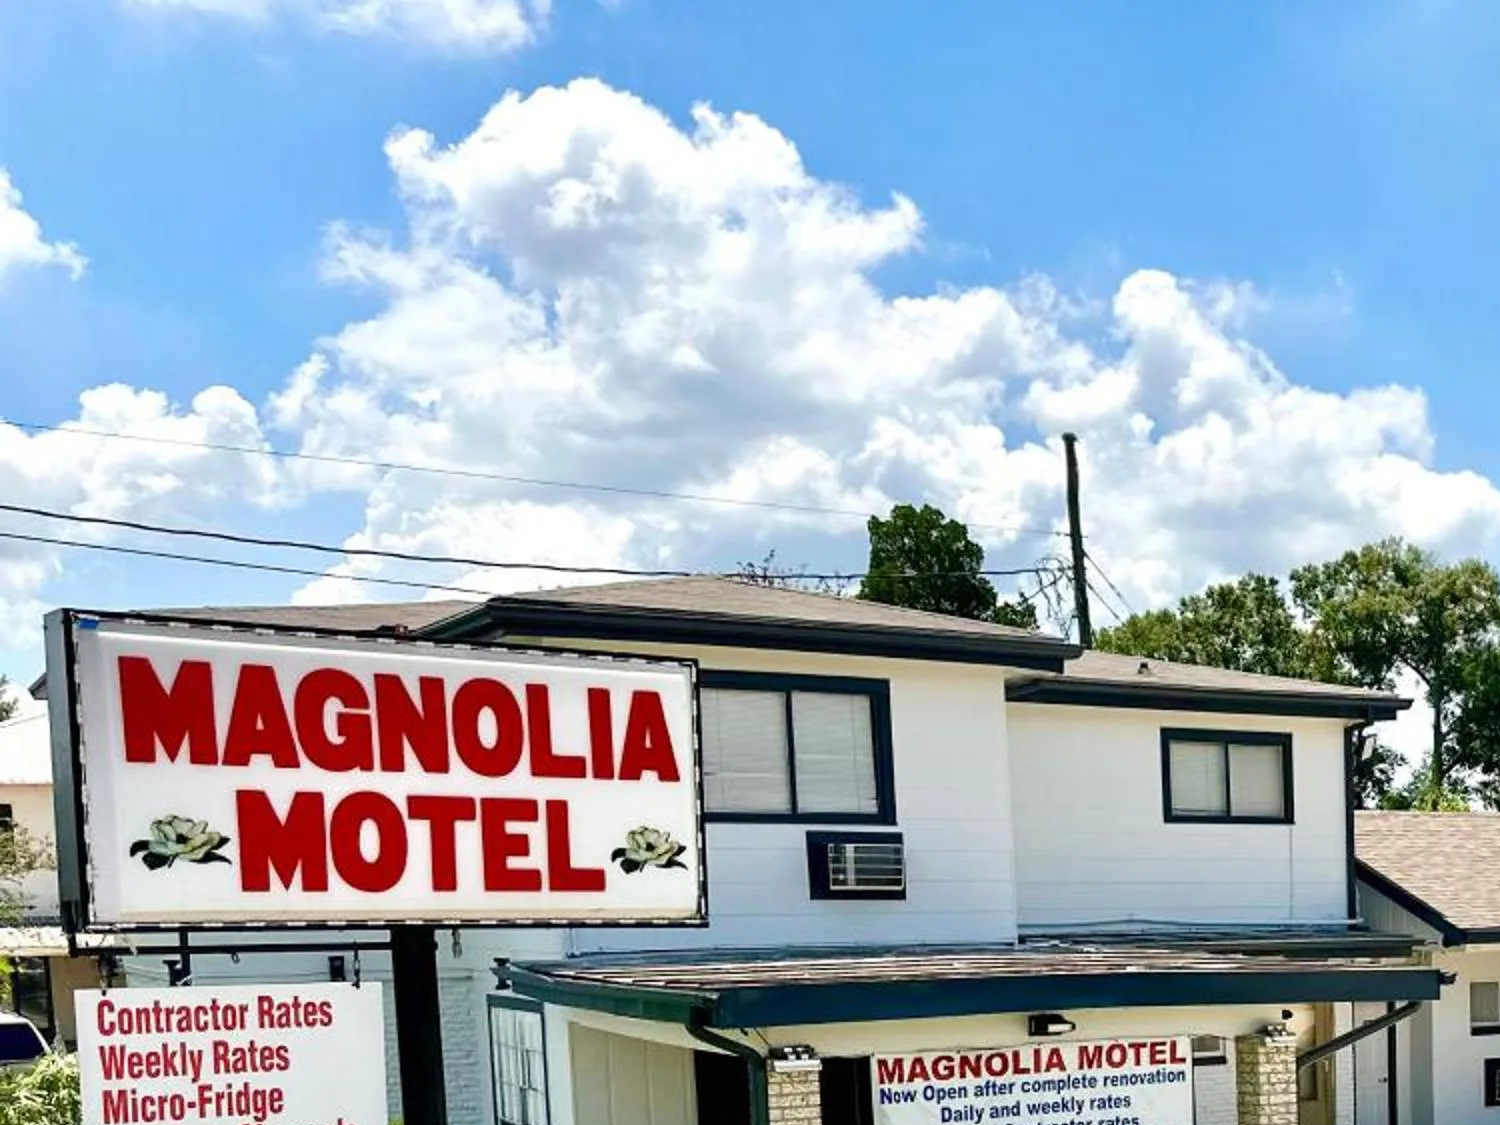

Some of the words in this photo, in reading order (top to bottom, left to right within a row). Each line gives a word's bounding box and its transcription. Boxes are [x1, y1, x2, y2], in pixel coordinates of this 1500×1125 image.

[118, 655, 681, 783] MAGNOLIA
[235, 789, 607, 893] MOTEL
[97, 998, 248, 1036] Contractor
[257, 995, 333, 1029] Rates
[98, 1041, 203, 1083] Weekly
[213, 1039, 290, 1075] Rates
[877, 1047, 1067, 1085] MAGNOLIA
[1077, 1040, 1187, 1070] MOTEL
[102, 1082, 285, 1125] Micro-Fridge
[879, 1088, 917, 1105] Now
[923, 1084, 967, 1104] Open
[974, 1079, 1015, 1099] after
[1020, 1074, 1098, 1098] complete
[1103, 1067, 1186, 1087] renovation
[990, 1099, 1021, 1119] and
[1027, 1095, 1085, 1117] weekly
[1090, 1094, 1132, 1111] rates
